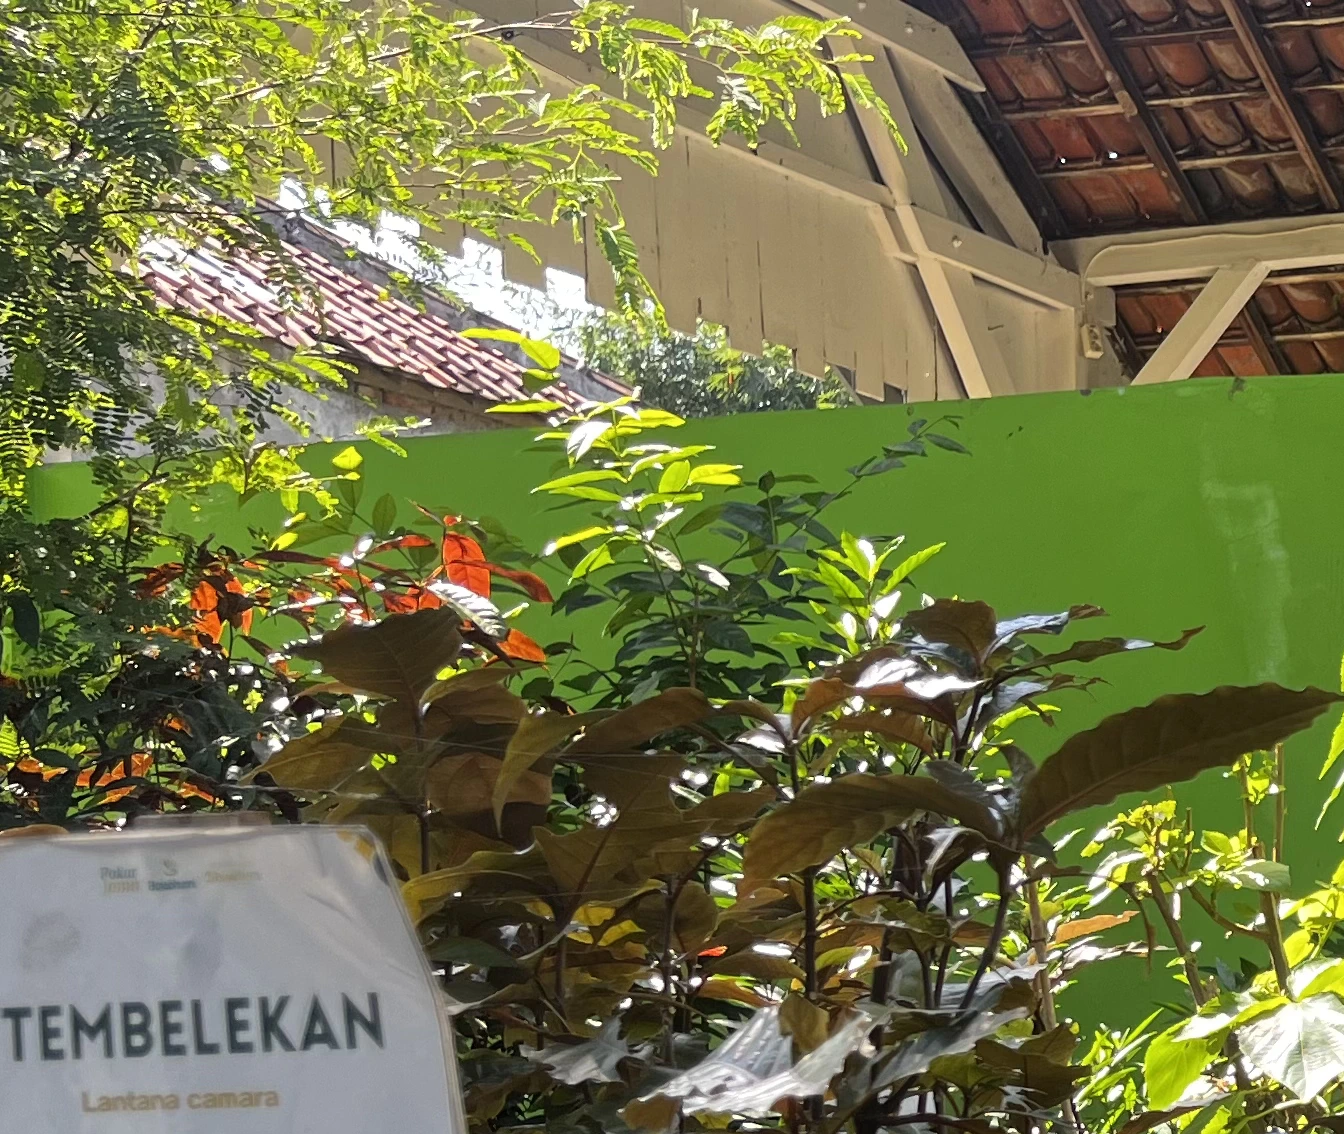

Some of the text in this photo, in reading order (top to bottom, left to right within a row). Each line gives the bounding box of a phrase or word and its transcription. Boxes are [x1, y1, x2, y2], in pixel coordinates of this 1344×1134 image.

[1, 991, 385, 1062] TEMBELEKAN
[80, 1089, 280, 1113] Lantana camara
